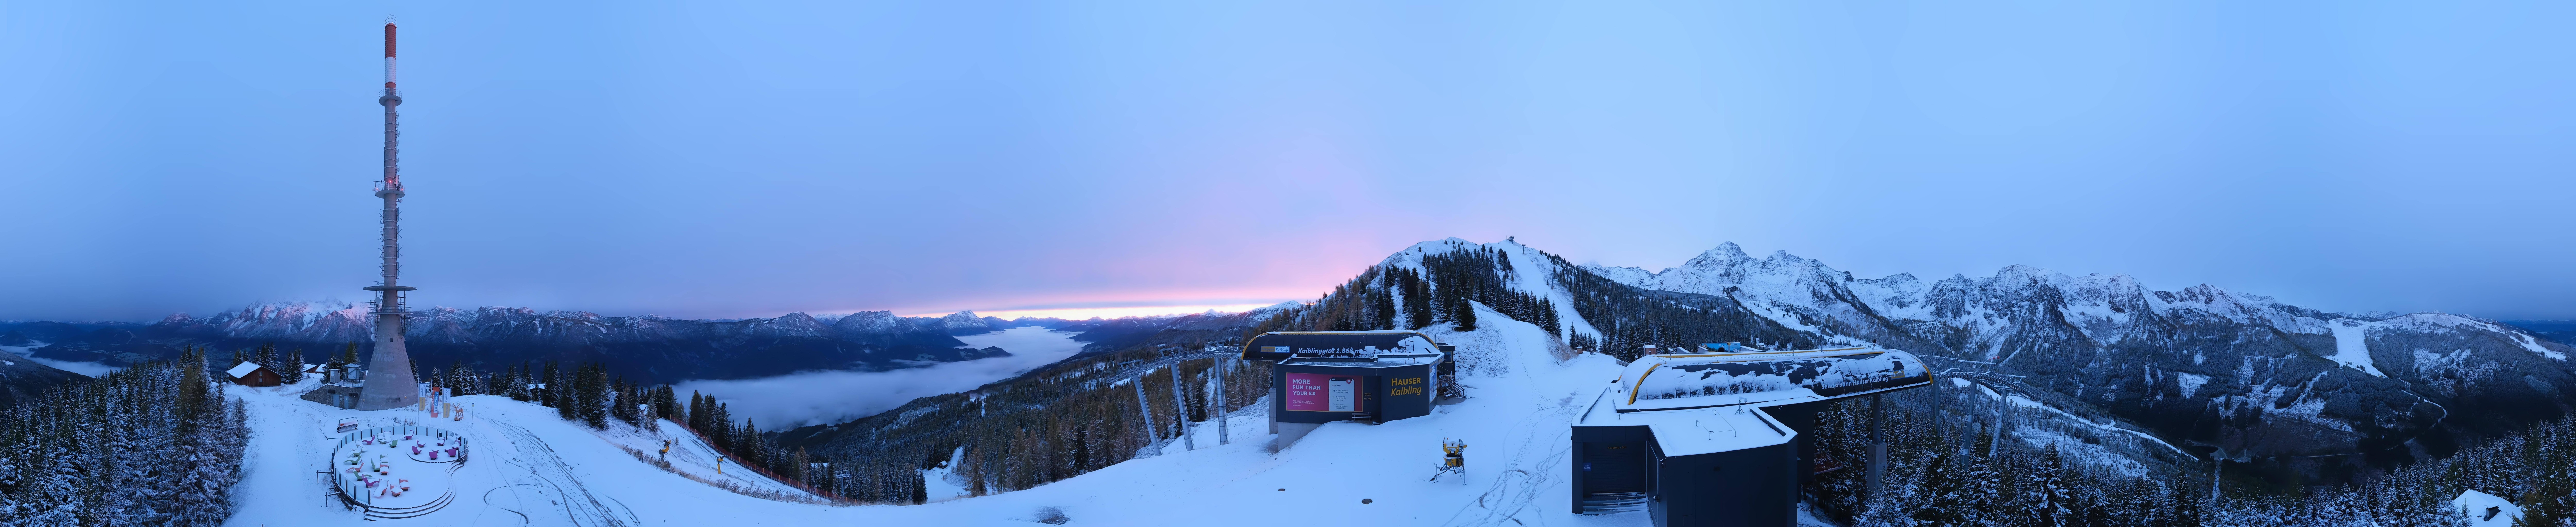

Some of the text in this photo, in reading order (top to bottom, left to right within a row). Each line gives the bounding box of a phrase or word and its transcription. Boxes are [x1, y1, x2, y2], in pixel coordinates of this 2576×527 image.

[1392, 377, 1421, 386] HAUSER
[1821, 381, 1852, 389] Senderbahn
[1391, 386, 1421, 396] Kaibling
